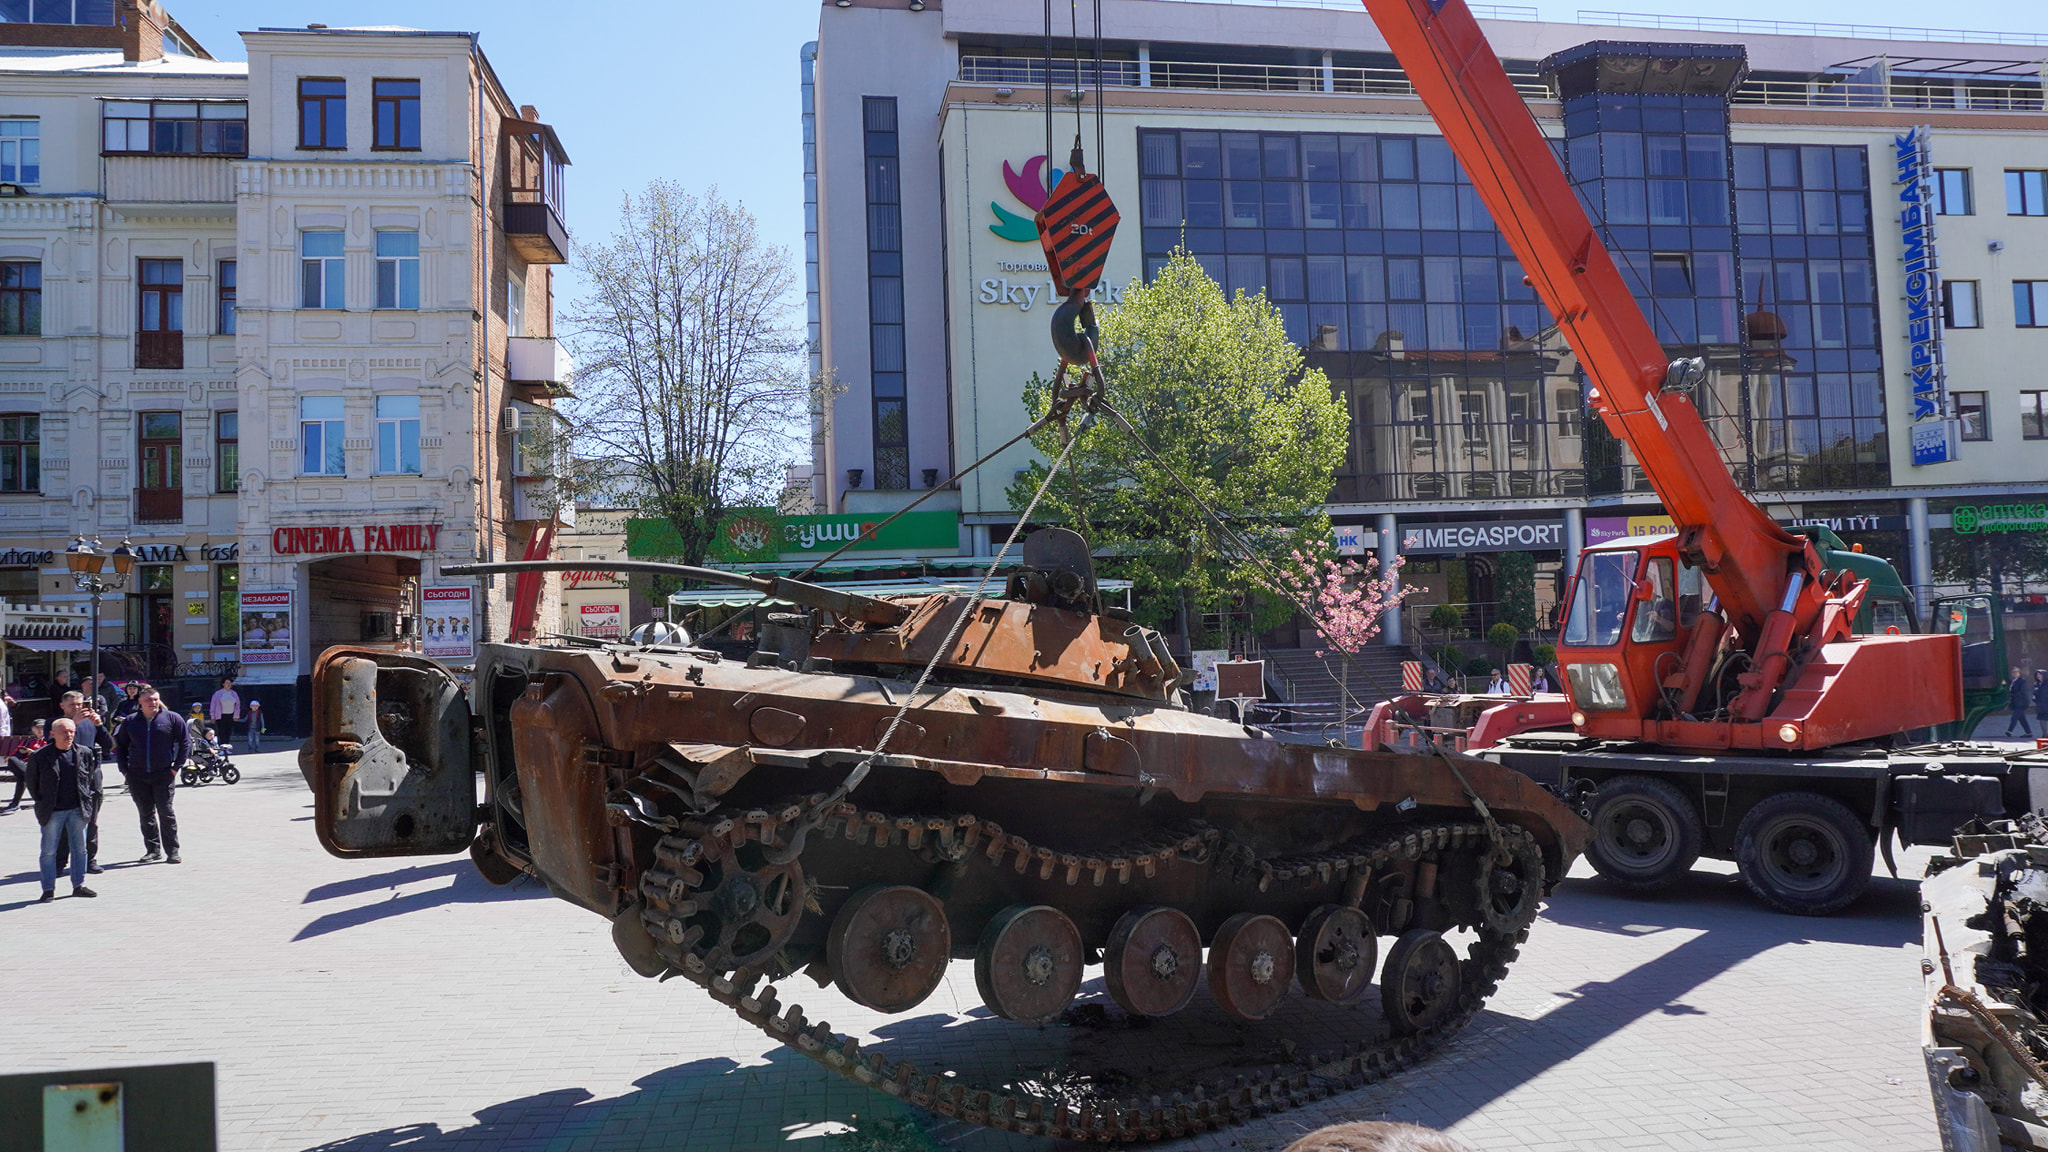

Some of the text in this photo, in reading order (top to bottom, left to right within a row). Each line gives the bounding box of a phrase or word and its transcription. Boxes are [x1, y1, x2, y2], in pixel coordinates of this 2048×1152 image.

[998, 260, 1049, 273] Торгови
[1895, 125, 1938, 421] УКРЕКСІМБАНК
[979, 278, 1040, 311] Sky
[1982, 504, 2047, 520] аптека
[273, 524, 440, 554] CINEMA FAMILY
[1425, 524, 1563, 548] MEGASPORT
[200, 543, 238, 560] fash
[242, 595, 288, 603] НЕЗАБАРОМ
[427, 590, 467, 599] СЬОГОДНІ
[585, 605, 615, 613] СЬОГОДНІ
